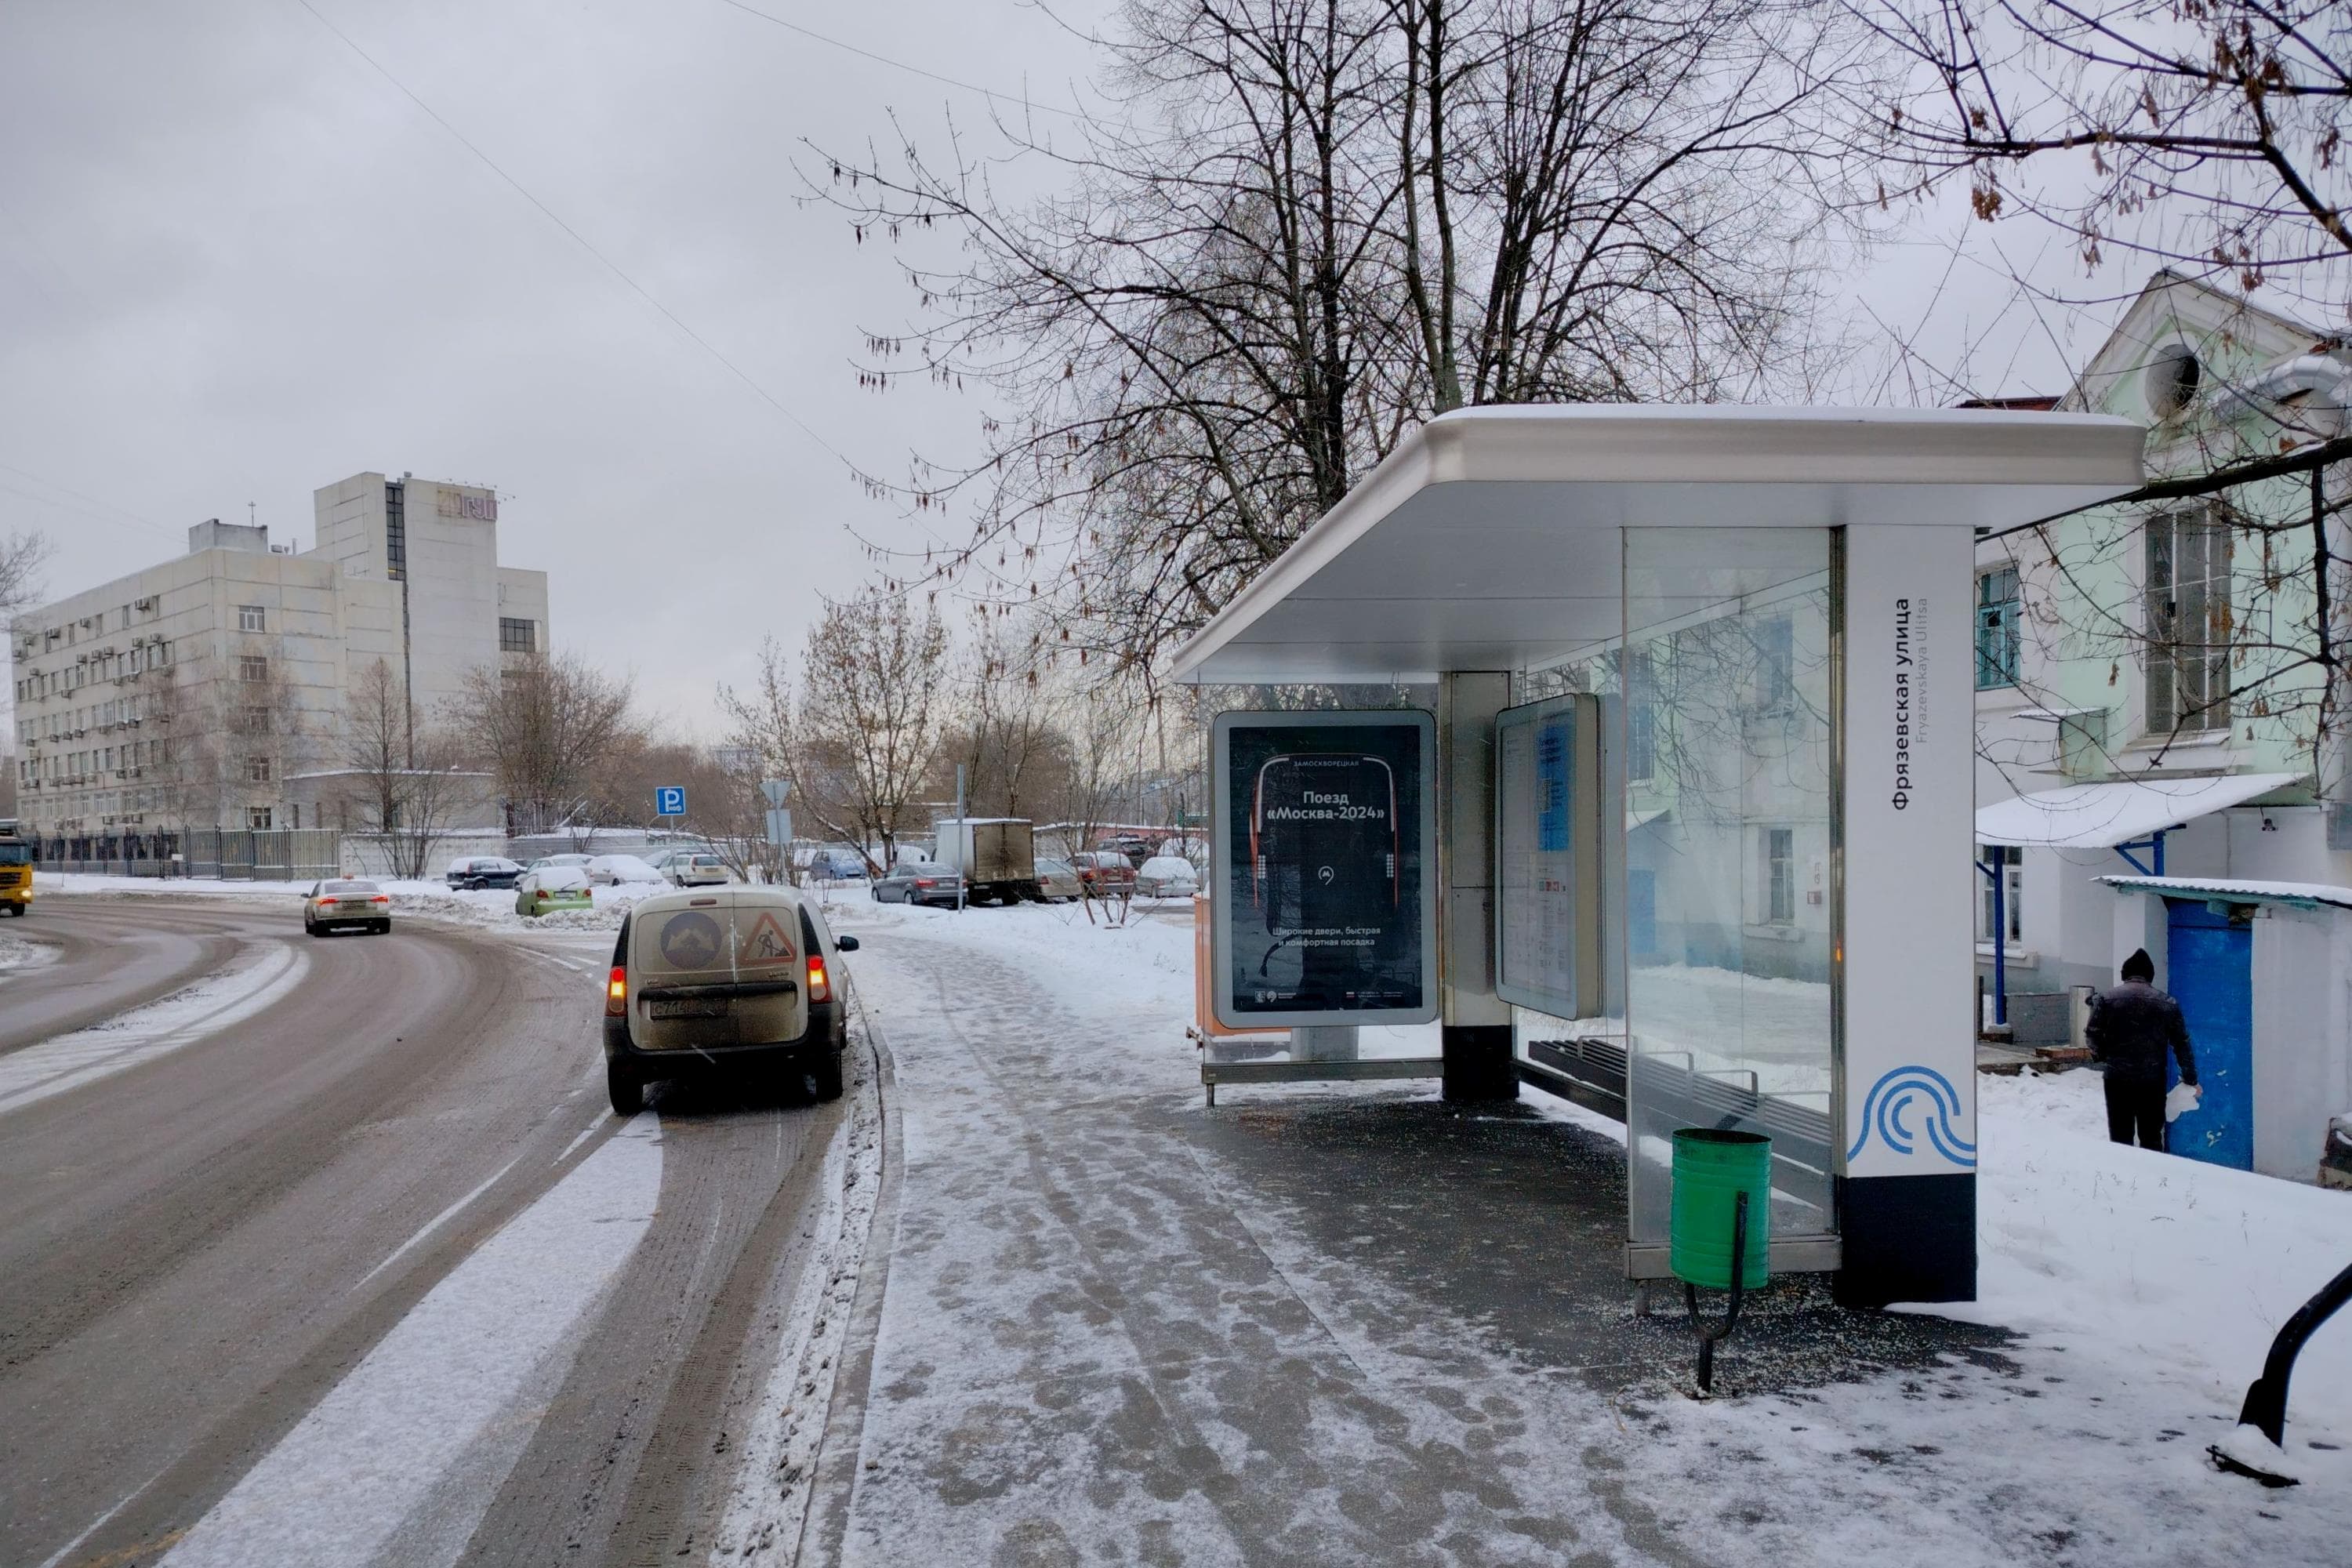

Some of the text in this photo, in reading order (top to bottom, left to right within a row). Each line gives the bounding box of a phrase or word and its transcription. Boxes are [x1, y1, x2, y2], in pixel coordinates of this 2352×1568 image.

[1915, 597, 1930, 743] Fryazevskaya Ulitsa
[1892, 598, 1913, 811] Фрязевская улица
[1303, 790, 1349, 805] Поезд
[1267, 806, 1385, 820] «Москва-2024»
[1272, 927, 1381, 937] Широкие двери, быстрая
[1286, 938, 1339, 948] комфортная
